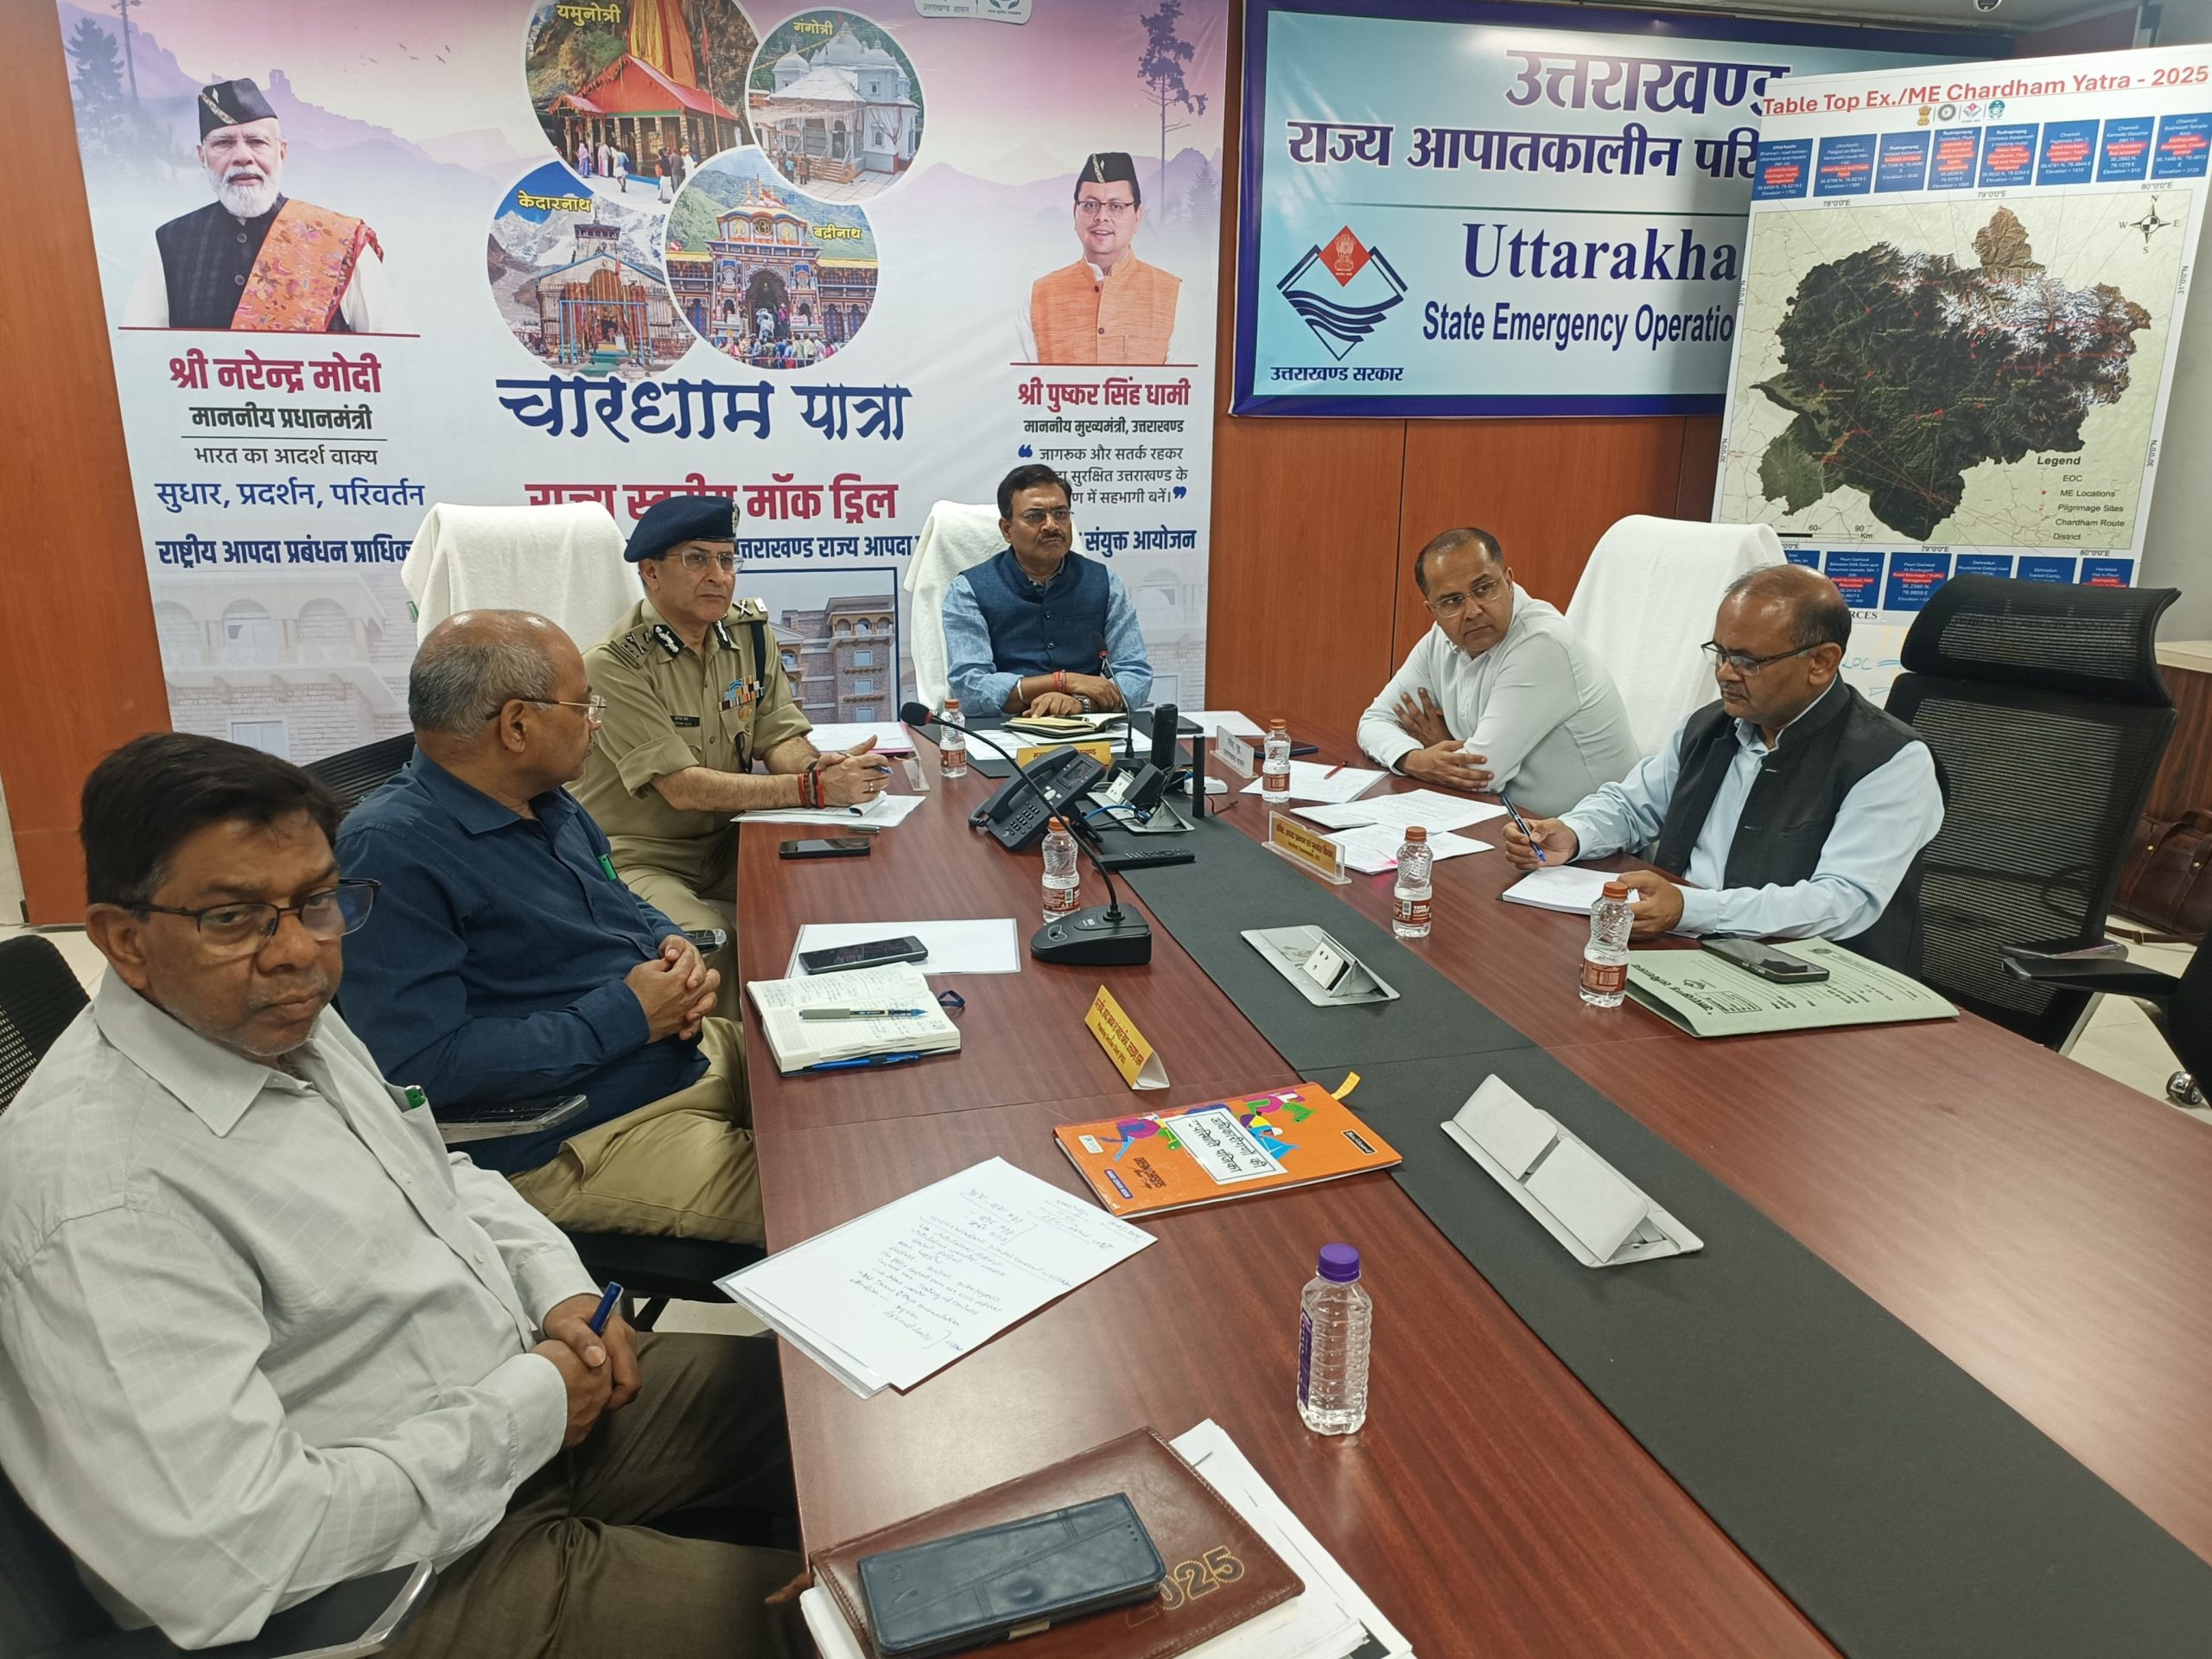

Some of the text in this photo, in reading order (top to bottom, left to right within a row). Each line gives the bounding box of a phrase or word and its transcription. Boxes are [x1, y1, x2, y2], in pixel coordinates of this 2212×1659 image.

[556, 2, 621, 26] यमुनोत्री
[793, 17, 833, 37] गंगोत्री
[1763, 98, 1818, 116] Table
[1823, 92, 1858, 112] Top
[1865, 87, 1941, 107] Ex./ME
[1947, 79, 2065, 100] Chardham
[2072, 73, 2132, 92] Yatra
[2151, 65, 2209, 86] 2025
[1287, 119, 1394, 167] राज्य
[1407, 123, 1682, 177] आपातकालीन
[518, 191, 592, 213] केदारनाथ
[813, 222, 862, 241] बद्रीनाथ
[1422, 300, 1485, 341] State
[1493, 301, 1627, 352] Emergency
[169, 347, 382, 394] श्री नरेन्द्र मोदी
[1269, 365, 1404, 383] उत्तराखण्ड सरकार
[1018, 376, 1191, 413] श्री पुष्कर सिंह धामी
[189, 401, 372, 430] माननीय प्रधानमंत्री
[495, 374, 913, 443] चारधाम यात्रा
[1023, 416, 1184, 437] माननीय मुख्यमंत्री, उत्तराखण्ड
[194, 444, 378, 466] भारत का आदर्श वाक्य
[1090, 444, 1112, 461] और
[1115, 446, 1147, 461] सतर्क
[1150, 448, 1184, 461] रहकर
[2037, 456, 2082, 467] Legend
[1071, 467, 1113, 486] सुरक्षित
[1116, 470, 1173, 482] उत्तराखण्ड
[1175, 467, 1188, 482] के
[155, 478, 425, 513] सुधार, प्रदर्शन, परिवर्तन
[743, 473, 823, 520] मॉक
[830, 473, 899, 524] ड्रिल
[1087, 488, 1098, 504] में
[1100, 488, 1144, 505] सहभागी
[2057, 504, 2101, 512] Pilgrimage
[2055, 518, 2098, 527] Chardham
[156, 533, 217, 569] राष्ट्रीय
[223, 540, 281, 564] आपदा
[284, 535, 348, 564] प्रबंधन
[818, 537, 861, 559] राज्य
[864, 536, 912, 557] आपदा
[1084, 524, 1197, 557] संयुक्त आयोजन
[1211, 1117, 1267, 1167] अधिकारीगणों की
[1217, 1149, 1243, 1173] पंजिका
